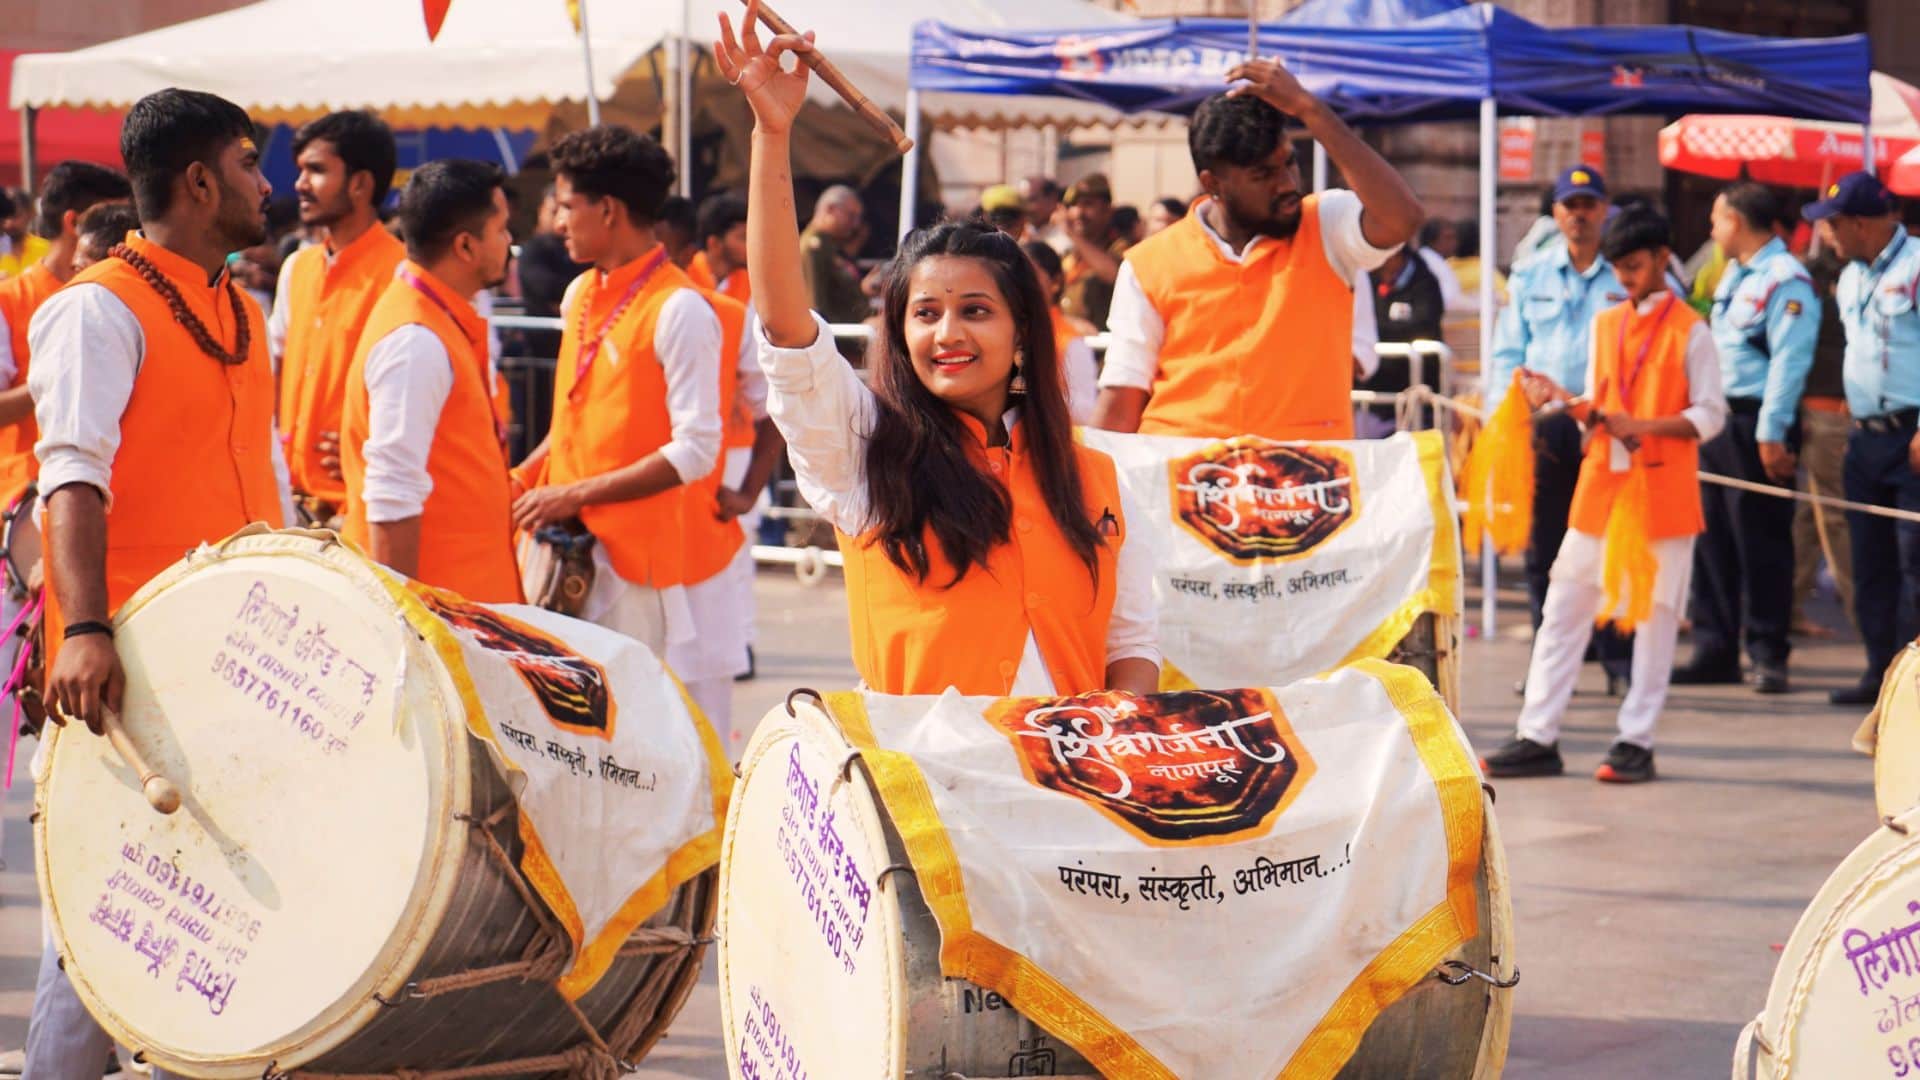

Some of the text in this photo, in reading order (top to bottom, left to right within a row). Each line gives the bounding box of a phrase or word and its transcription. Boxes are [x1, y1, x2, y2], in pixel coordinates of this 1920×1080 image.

[1016, 705, 1287, 800] शिवगर्जना
[1146, 756, 1243, 784] नागपूर
[776, 826, 843, 959] 9657761160
[1057, 860, 1130, 904] परंपरा,
[1138, 864, 1225, 910] संस्कृती,
